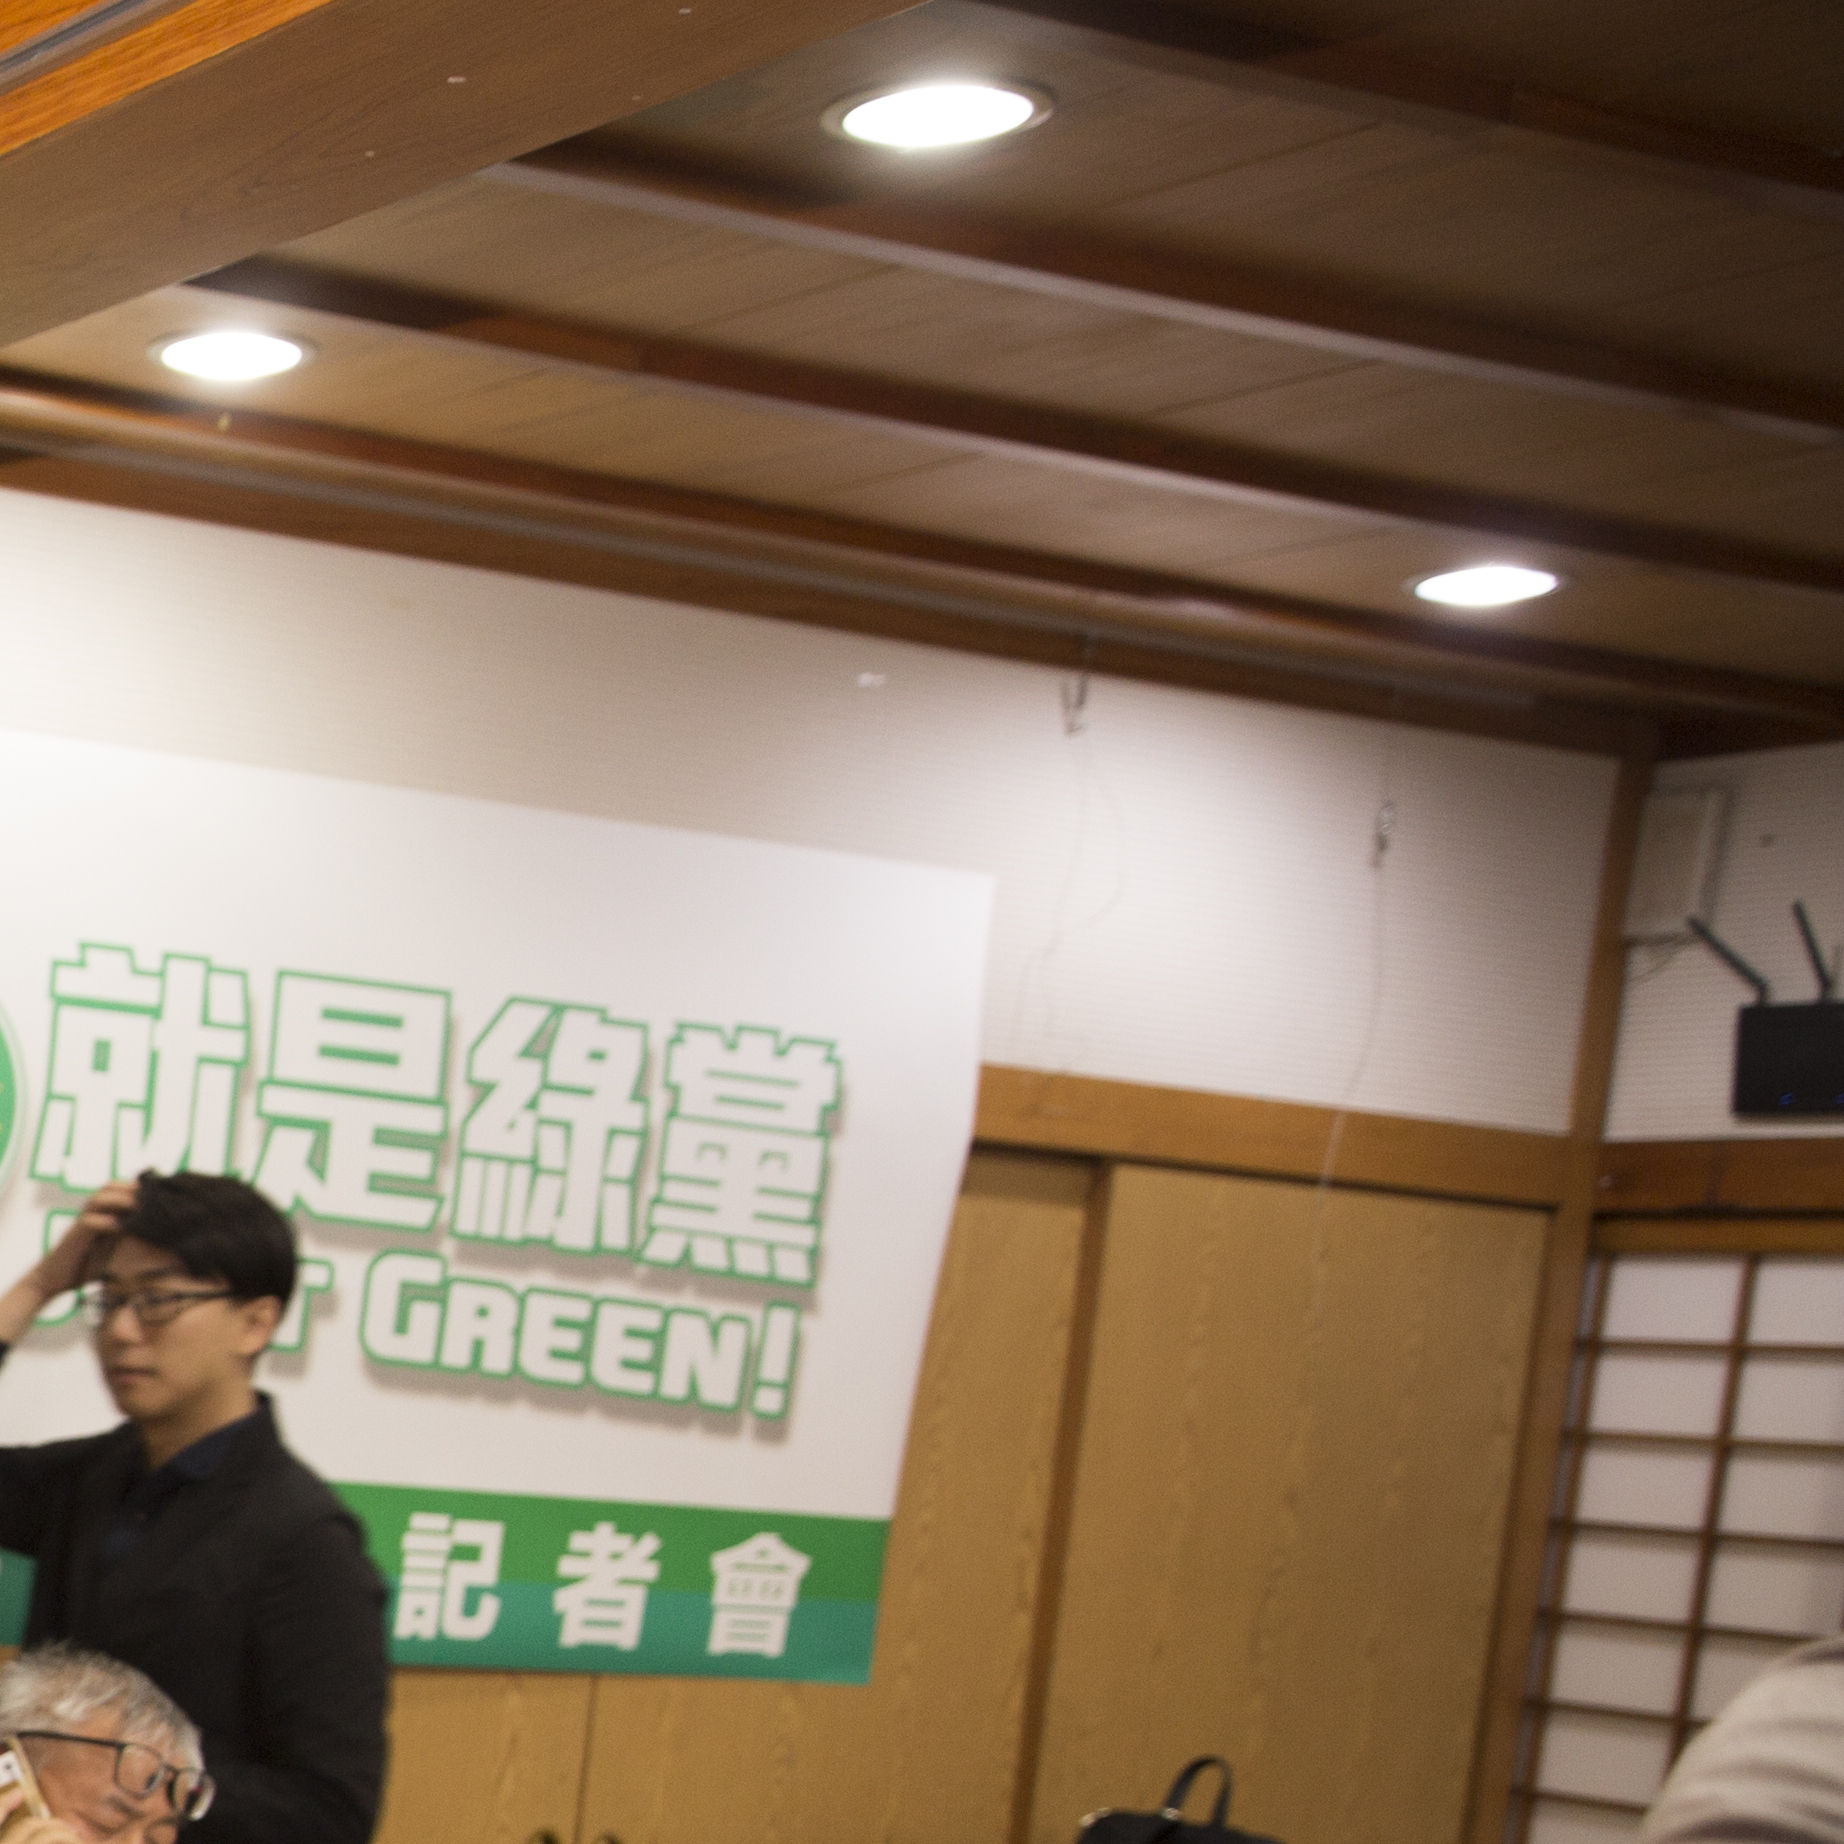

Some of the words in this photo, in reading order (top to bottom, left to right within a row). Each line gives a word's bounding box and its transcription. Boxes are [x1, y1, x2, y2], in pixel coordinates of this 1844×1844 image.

[29, 940, 844, 1291] 就是綠黨
[359, 1247, 802, 1420] GREEN!
